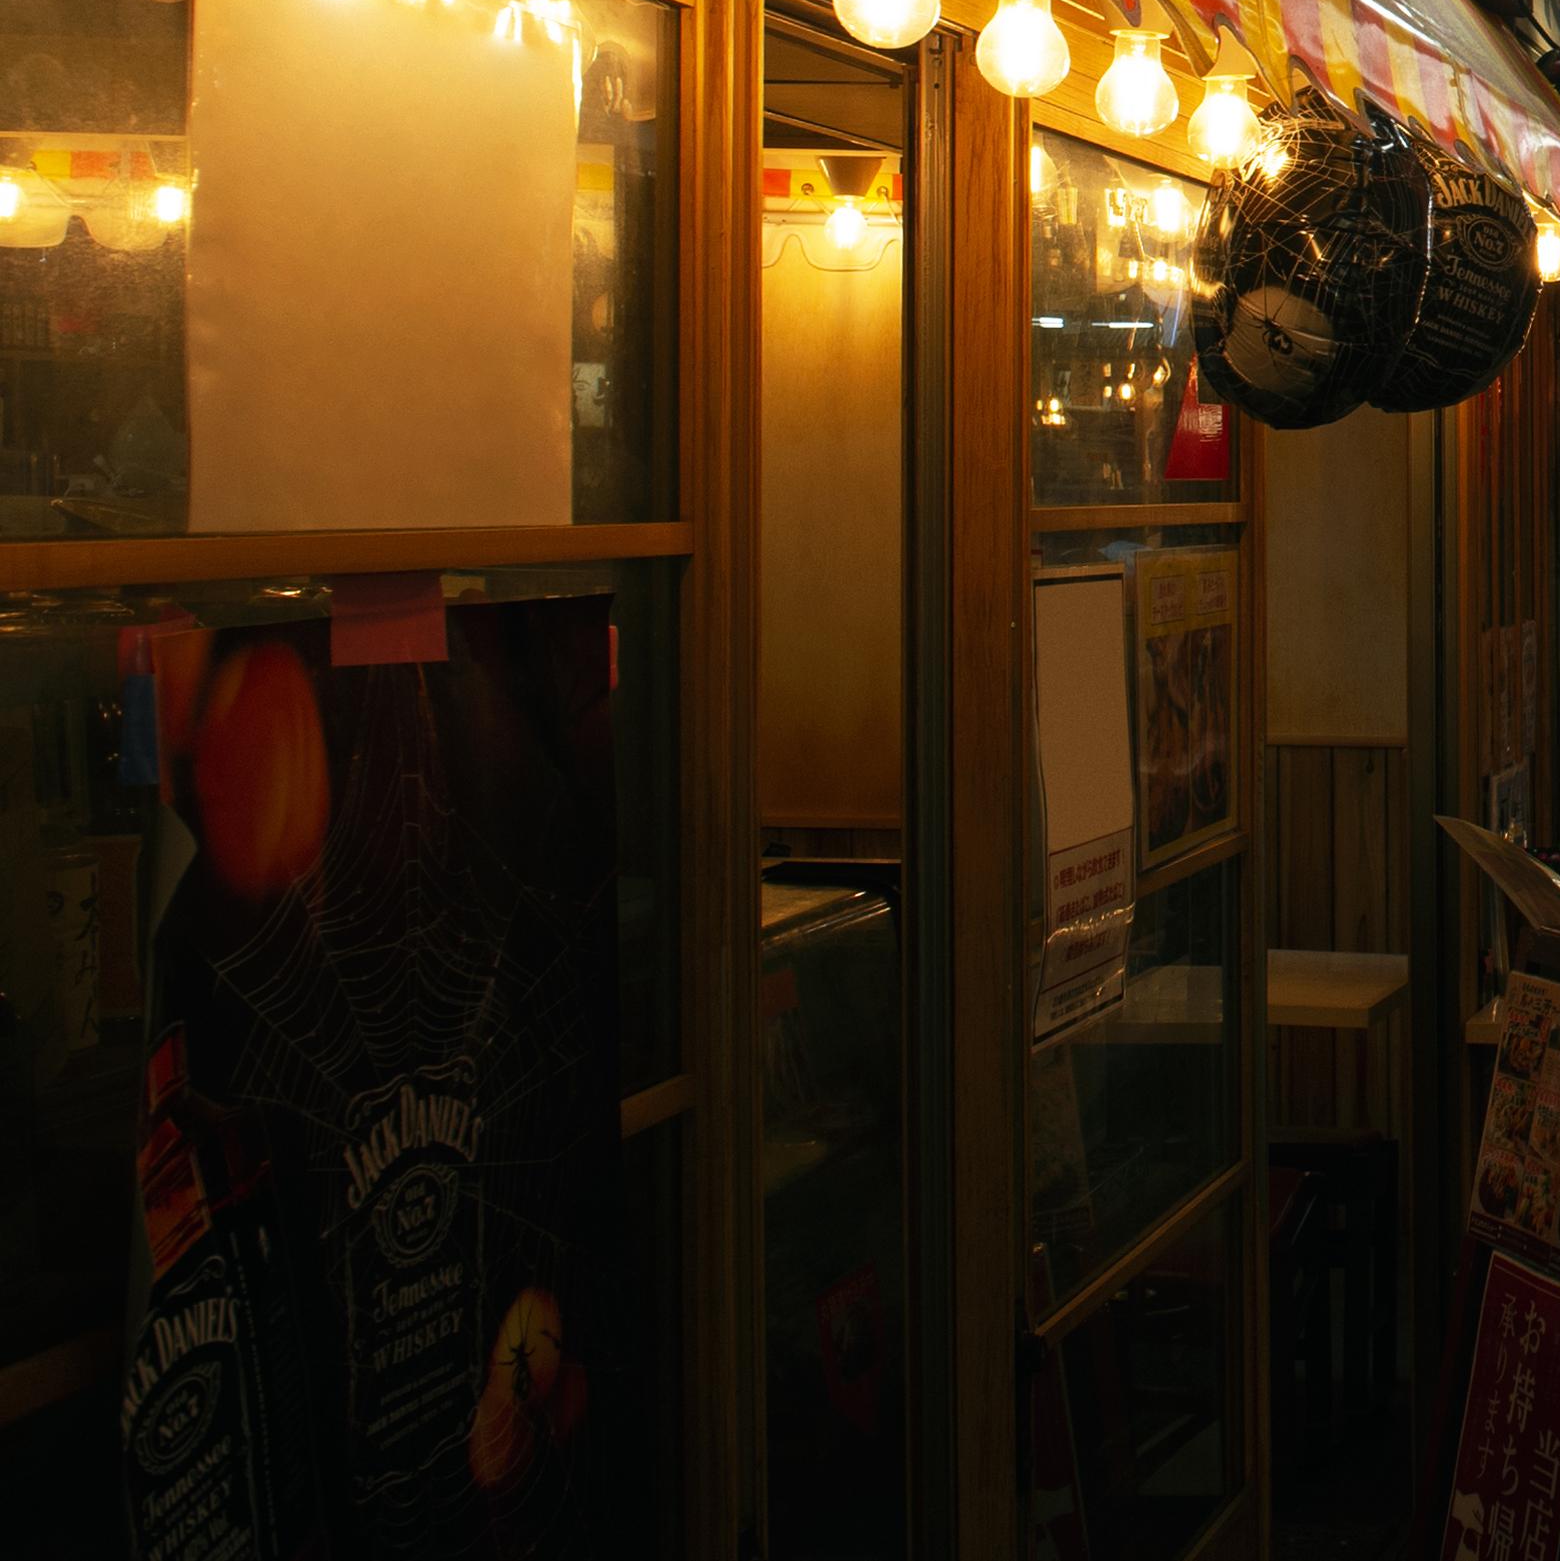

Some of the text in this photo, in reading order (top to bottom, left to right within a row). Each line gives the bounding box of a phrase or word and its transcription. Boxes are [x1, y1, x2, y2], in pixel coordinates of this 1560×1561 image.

[1433, 172, 1484, 209] JACK
[1438, 286, 1505, 324] WHISKEY
[342, 1082, 483, 1209] JACK DANIEL'S
[373, 1307, 465, 1374] WHISKEY
[1476, 1290, 1518, 1480] 承ります
